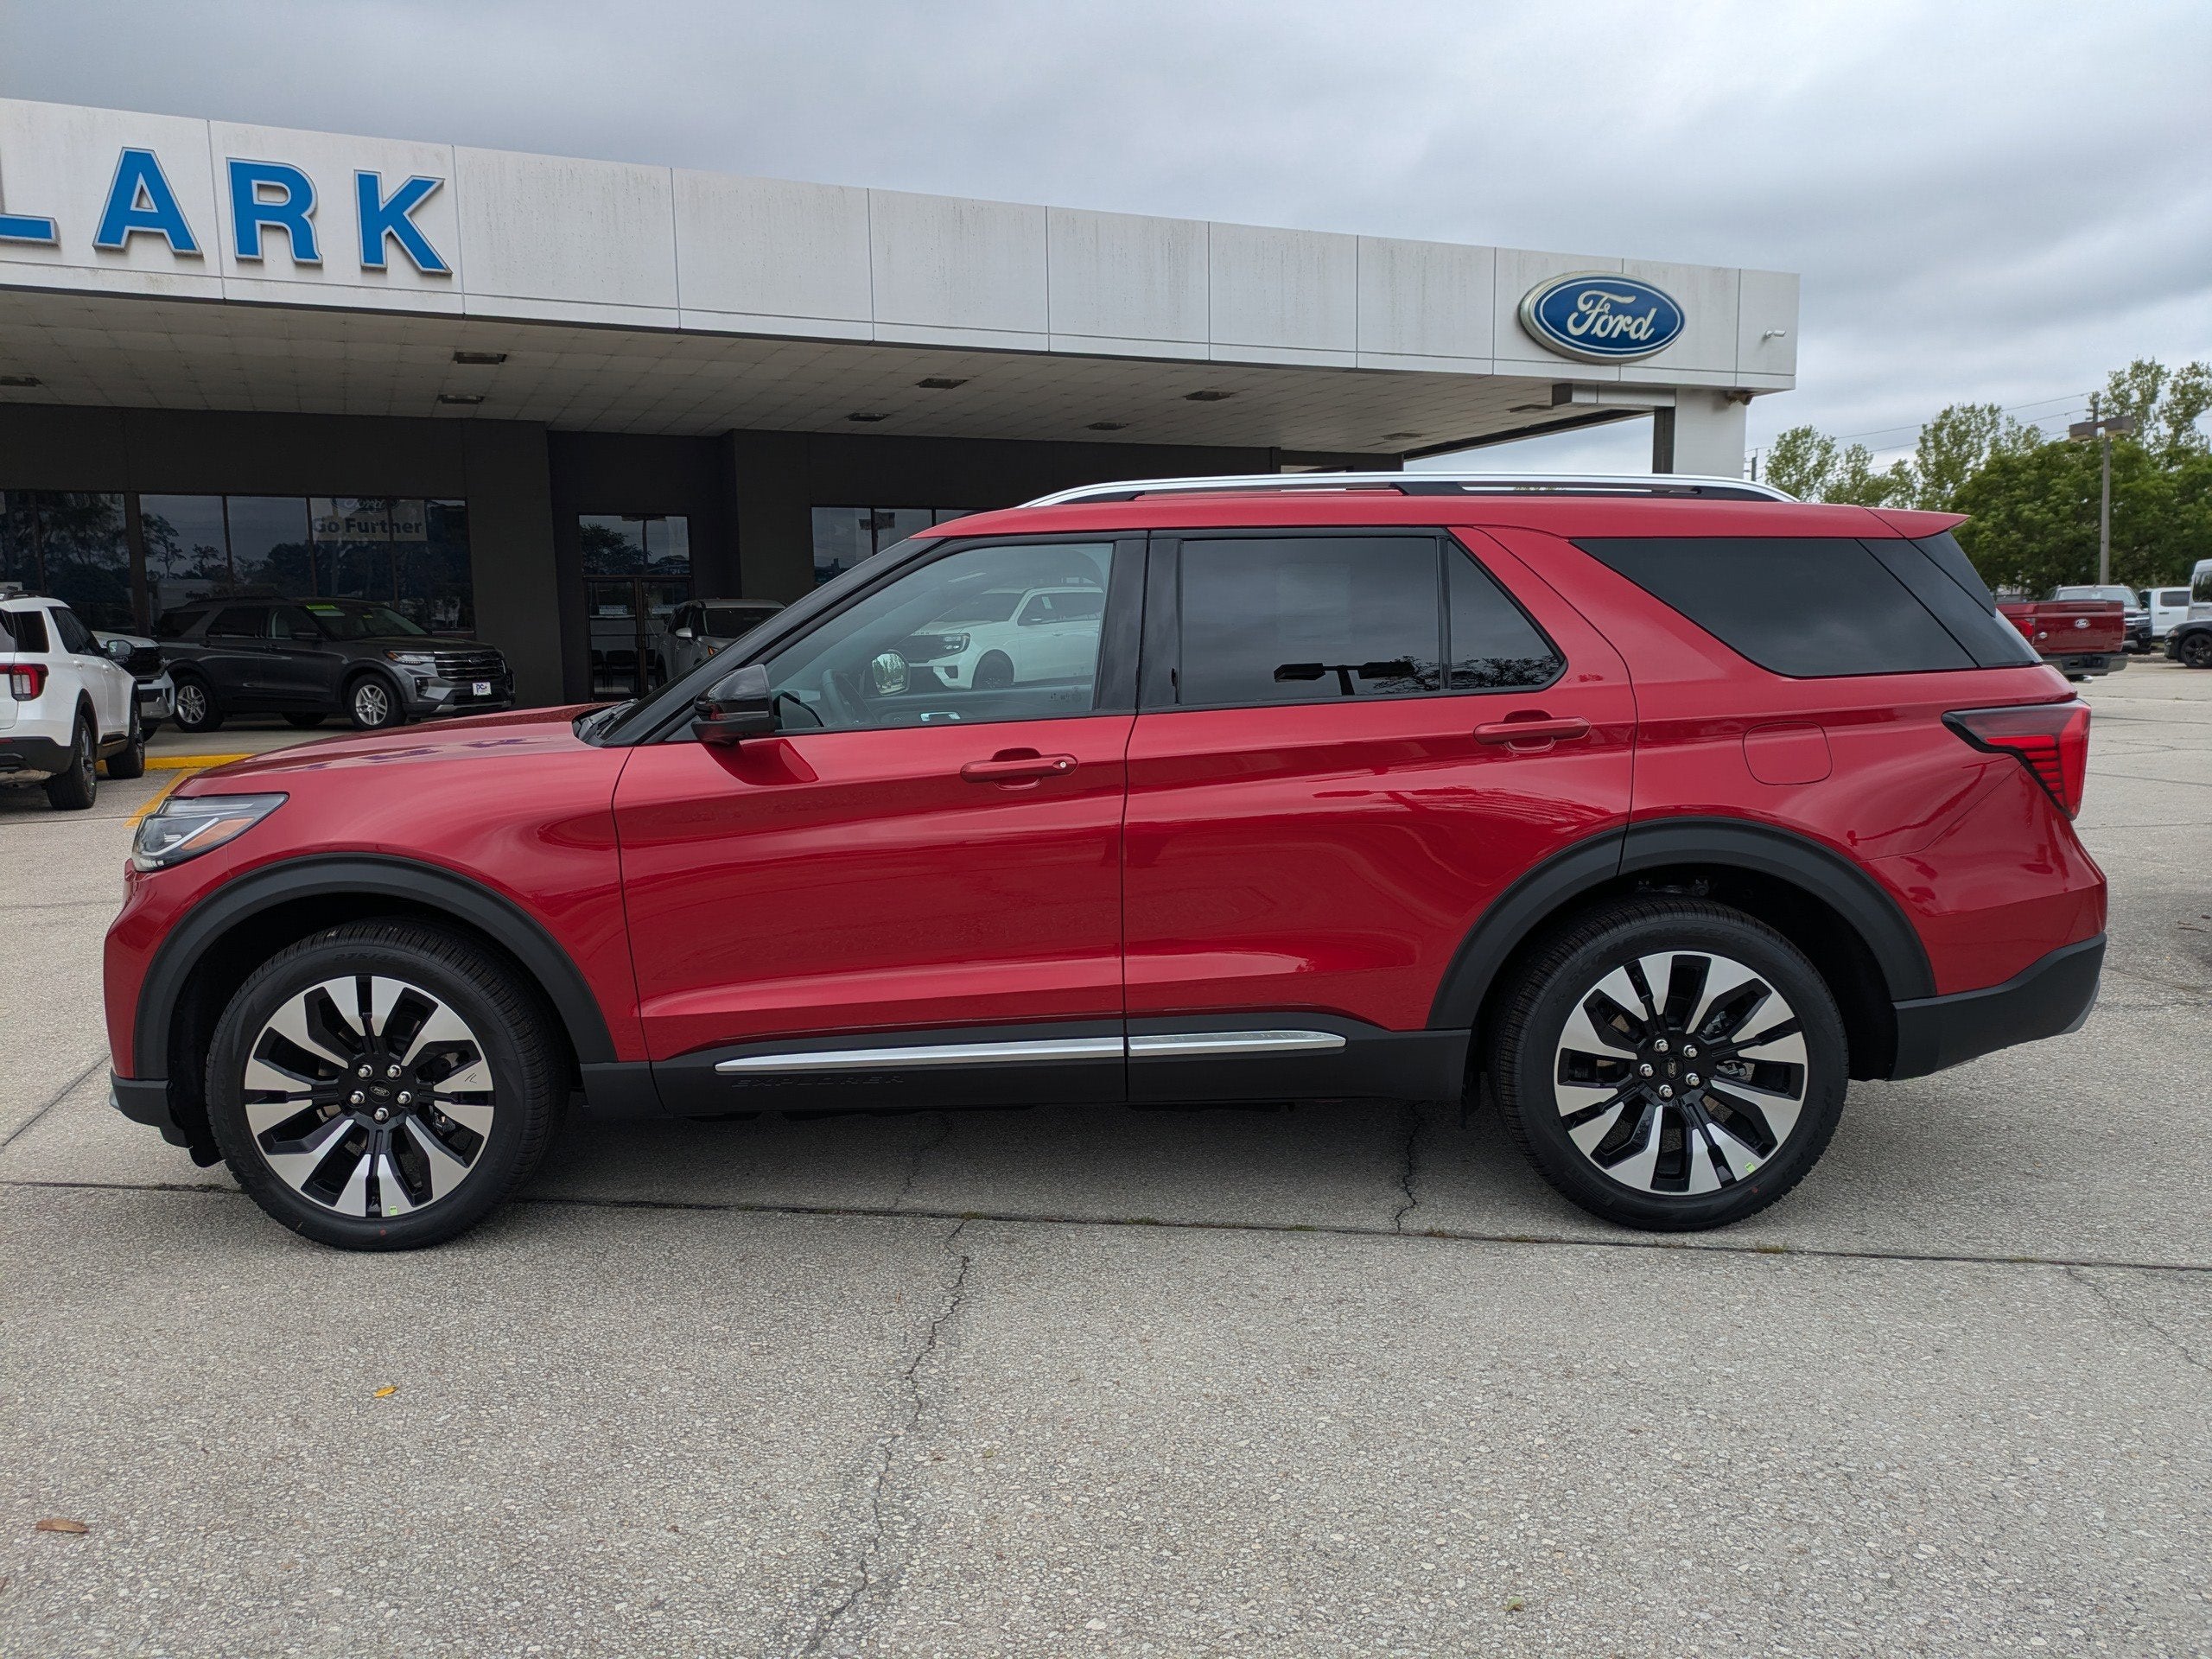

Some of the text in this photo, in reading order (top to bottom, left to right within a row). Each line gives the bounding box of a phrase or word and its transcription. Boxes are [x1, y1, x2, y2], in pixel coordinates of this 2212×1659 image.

[1567, 289, 1657, 340] Ford
[312, 517, 340, 533] Go
[731, 1076, 905, 1088] EXPLORER
